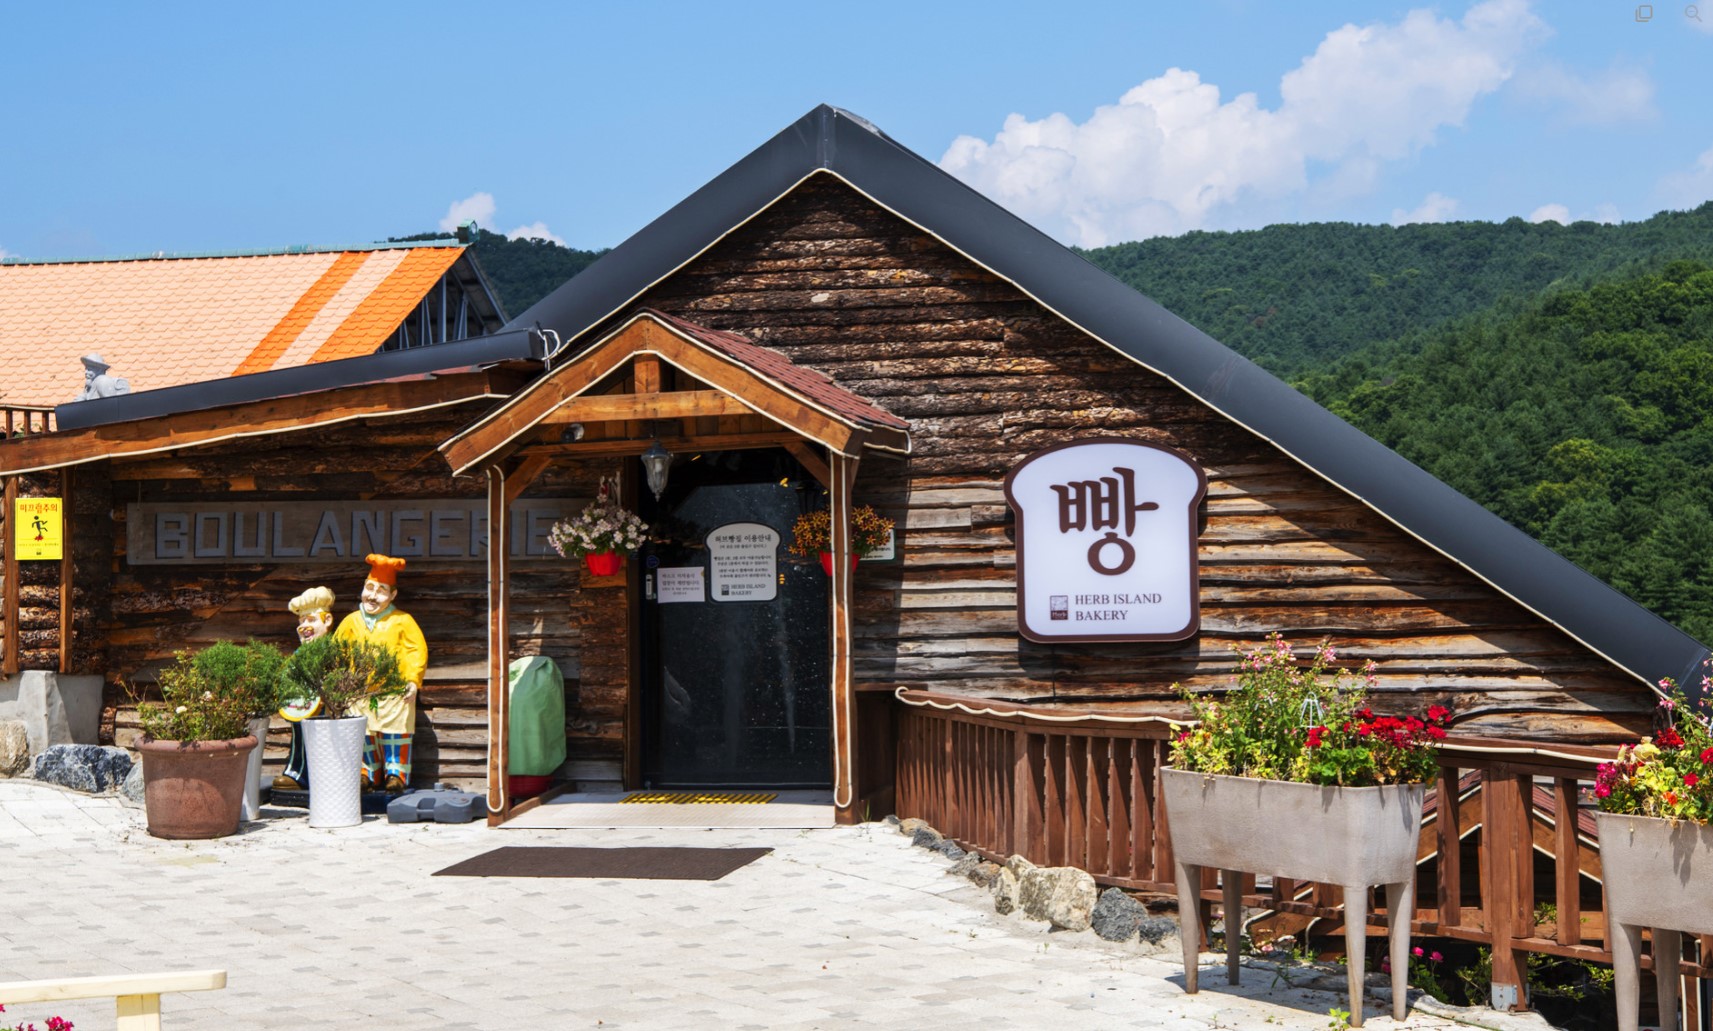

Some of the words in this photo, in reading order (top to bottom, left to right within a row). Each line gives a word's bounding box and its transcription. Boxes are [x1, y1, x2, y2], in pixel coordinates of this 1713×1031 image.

[1050, 467, 1159, 576] 빵
[744, 534, 772, 542] 이용안내
[1075, 594, 1110, 605] HERB
[1113, 593, 1162, 605] ISLAND
[1075, 610, 1129, 621] BAKERY
